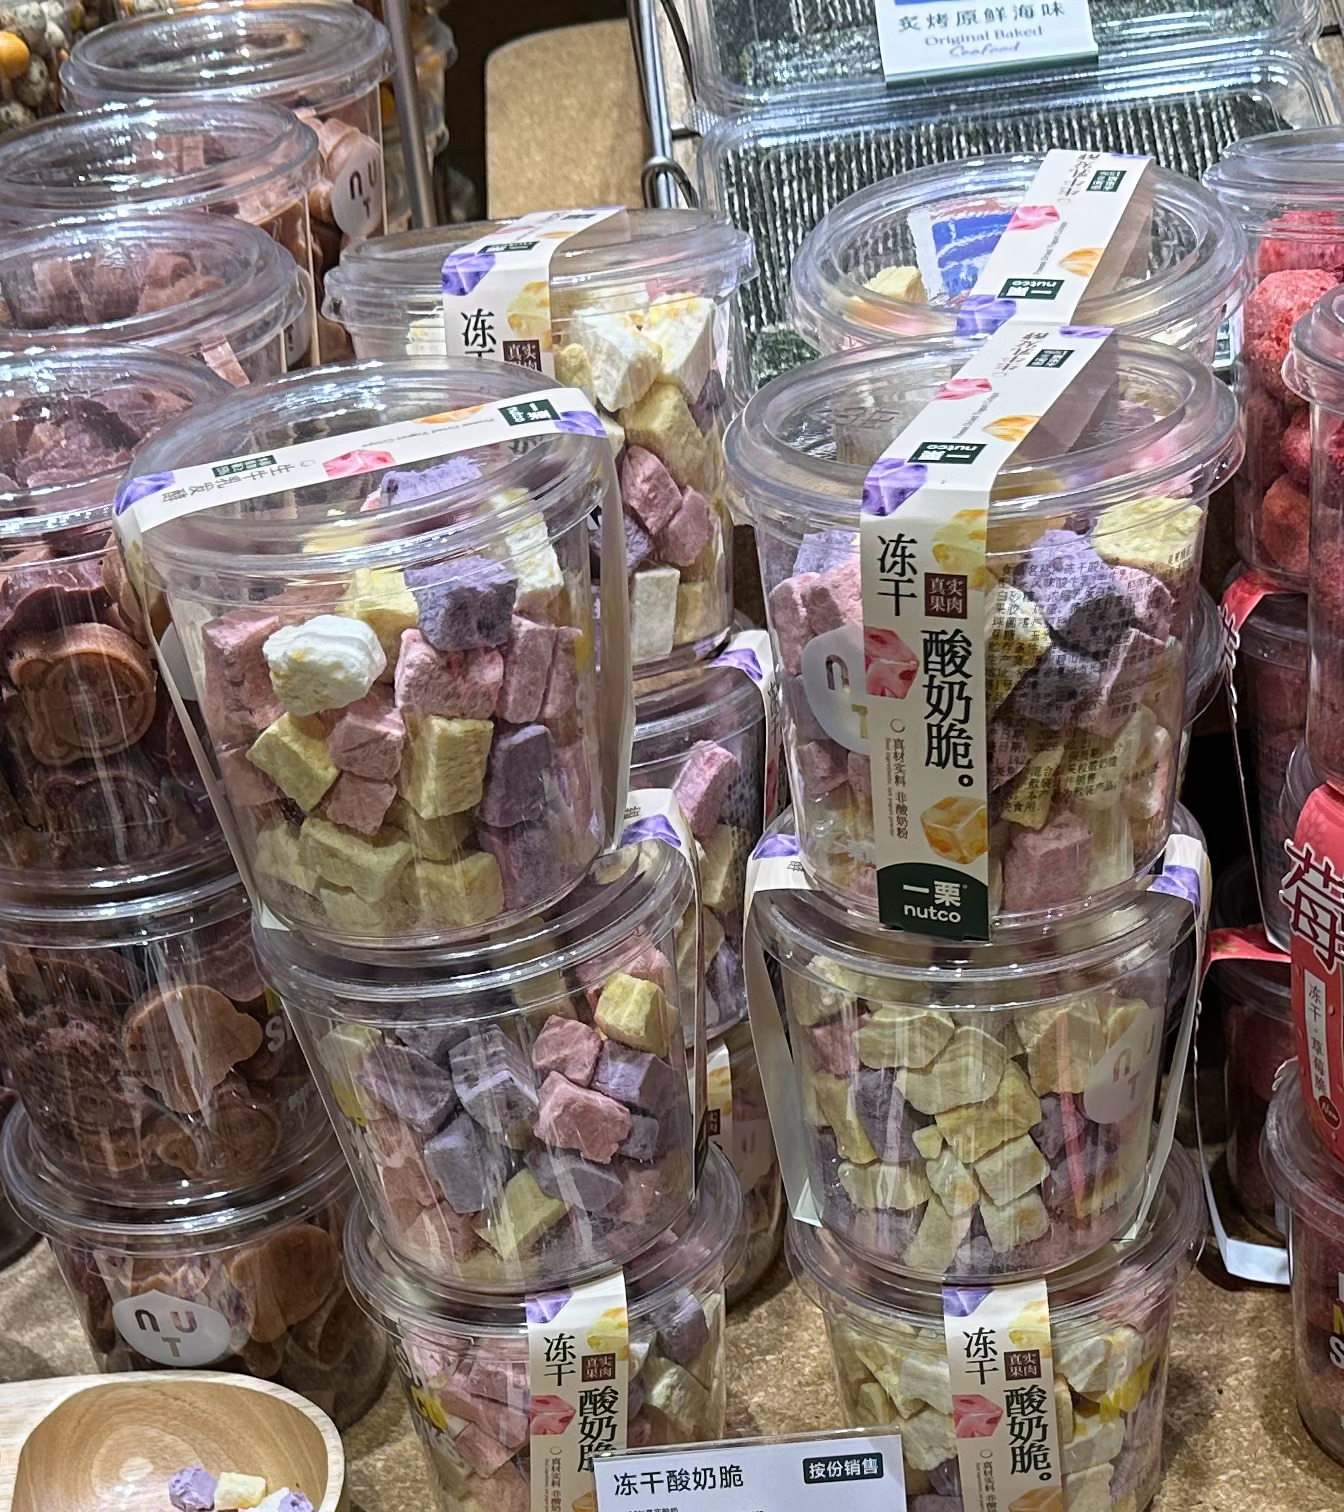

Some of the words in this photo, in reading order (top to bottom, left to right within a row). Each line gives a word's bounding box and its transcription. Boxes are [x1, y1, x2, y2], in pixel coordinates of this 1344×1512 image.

[899, 3, 1065, 33] 炙烤原鲜海味
[925, 30, 990, 47] Original
[995, 25, 1043, 41] Baked
[876, 532, 918, 616] 冻干
[929, 577, 964, 597] 真实
[929, 595, 964, 615] 果肉
[903, 880, 961, 908] 一栗
[903, 903, 962, 924] nutco
[543, 1332, 577, 1387] 冻干
[962, 1326, 1000, 1386] 冻干
[613, 1464, 745, 1496] 冻干酸奶脆
[808, 1457, 880, 1480] 按份销售
